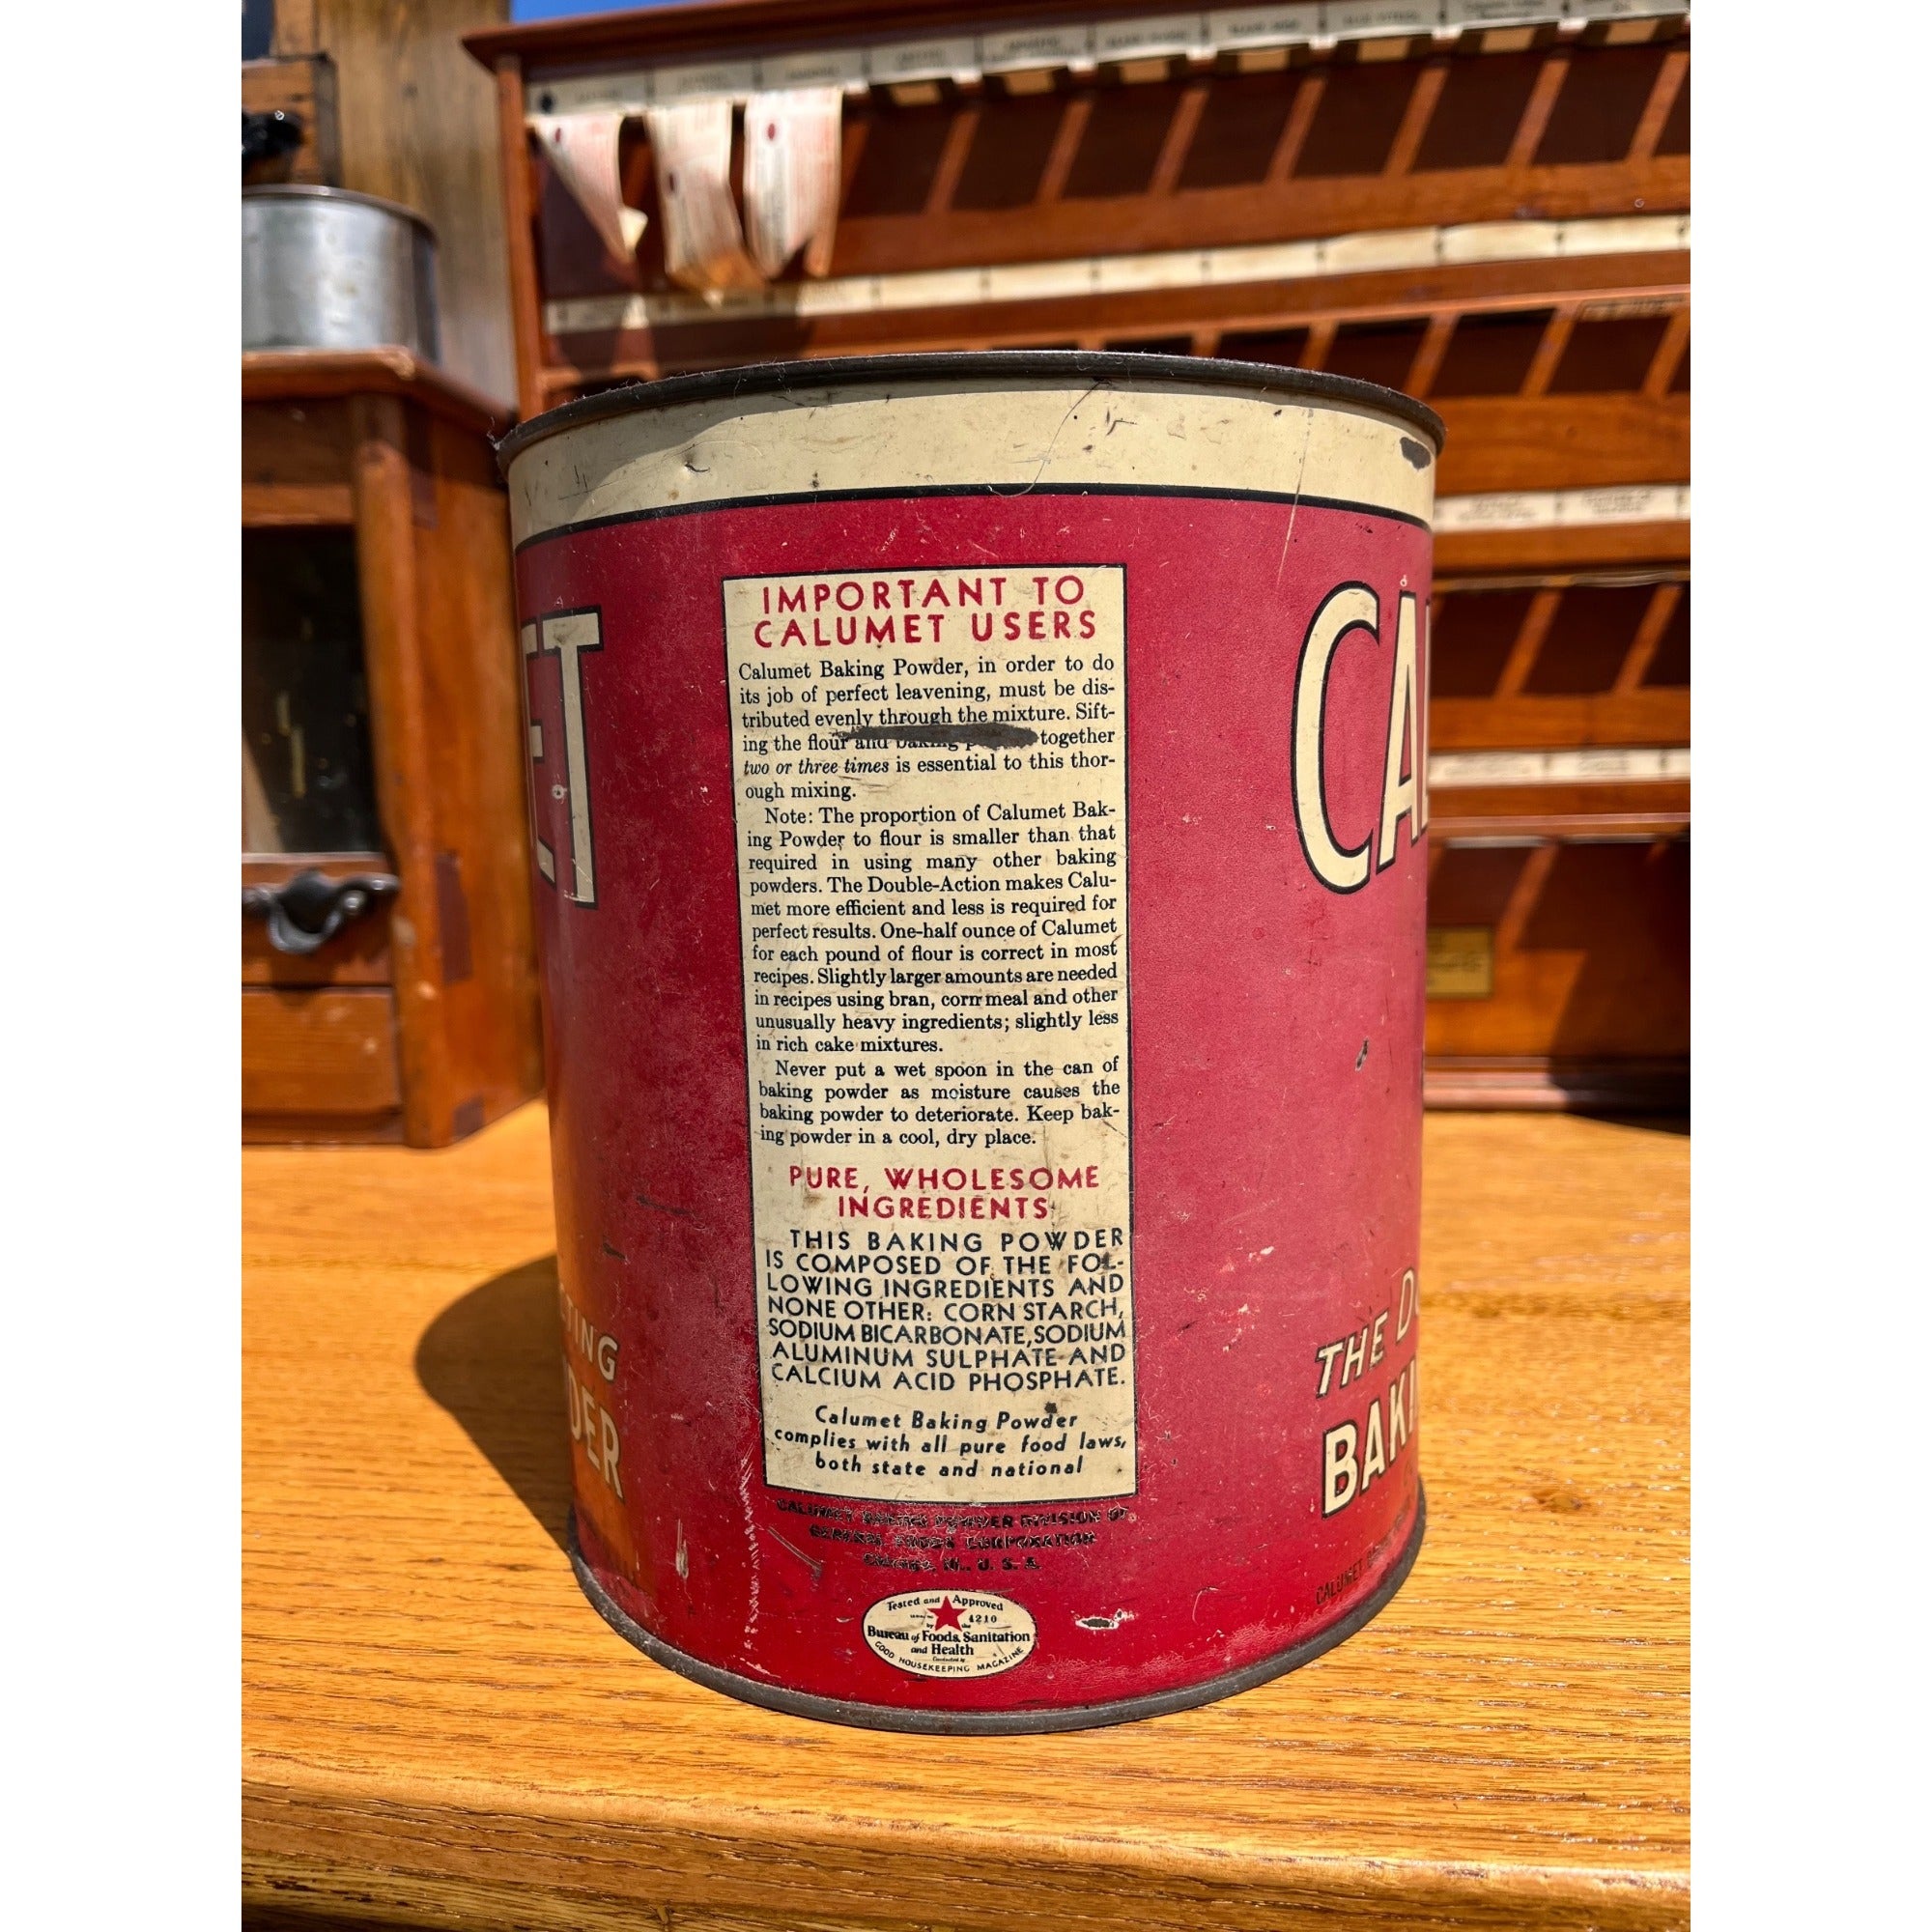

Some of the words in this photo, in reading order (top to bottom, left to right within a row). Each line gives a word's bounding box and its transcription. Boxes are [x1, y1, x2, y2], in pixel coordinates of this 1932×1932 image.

[763, 578, 1007, 614] IMPORTANT
[1033, 575, 1084, 606] TO
[754, 614, 945, 648] CALUMET
[972, 610, 1095, 641] USERS
[738, 662, 811, 680] Calumet
[819, 660, 885, 680] Baking
[893, 657, 969, 678] Powder,
[978, 657, 997, 673] in
[1006, 654, 1056, 673] order
[1065, 655, 1084, 671] to
[1093, 653, 1114, 670] do
[740, 687, 760, 704] its
[767, 686, 793, 707] job
[801, 685, 818, 702] of
[826, 684, 889, 706] perfect
[895, 683, 990, 702] leavening,
[999, 680, 1046, 697] must
[1054, 678, 1075, 696] be
[1082, 678, 1115, 696] dis-
[742, 711, 810, 728] tributed
[815, 712, 871, 727] evenly
[879, 707, 952, 725] through
[958, 707, 988, 724] the
[993, 706, 1070, 723] mixture.
[1076, 702, 1116, 720] Sift-
[745, 781, 785, 803] ough
[791, 785, 856, 802] mixing.
[764, 807, 812, 824] Note:
[818, 807, 854, 824] The
[860, 807, 956, 827] proportion
[962, 804, 980, 821] of
[987, 803, 1066, 821] Calumet
[1072, 800, 1116, 818] Bak-
[749, 853, 817, 874] required
[832, 855, 850, 869] in
[864, 858, 912, 873] using
[926, 855, 978, 872] many
[993, 850, 1041, 868] other
[1056, 848, 1117, 867] baking
[750, 876, 822, 896] powders.
[827, 876, 863, 894] The
[867, 875, 1001, 893] Double-Action
[1005, 873, 1064, 891] makes
[1067, 870, 1117, 889] Calu-
[753, 923, 809, 942] perfect
[812, 922, 876, 939] results.
[880, 922, 958, 939] One-half
[962, 925, 1015, 938] ounce
[1019, 920, 1037, 937] of
[1041, 918, 1118, 936] Calumet
[753, 967, 814, 988] recipes.
[817, 967, 887, 988] Slightly
[890, 967, 942, 988] larger
[945, 968, 1023, 984] amounts
[1026, 971, 1054, 982] are
[1057, 961, 1118, 981] needed
[755, 1013, 836, 1034] unusually
[842, 1013, 896, 1033] heavy
[902, 1012, 1009, 1033] ingredients;
[1015, 1010, 1083, 1032] slightly
[1089, 1009, 1119, 1026] less
[756, 1037, 771, 1050] in
[776, 1036, 809, 1052] rich
[815, 1036, 855, 1052] cake
[860, 1037, 943, 1053] mixtures.
[759, 1080, 813, 1103] baking
[824, 1083, 889, 1103] powder
[900, 1088, 920, 1099] as
[931, 1085, 1010, 1099] moisture
[1023, 1084, 1080, 1099] causes
[1093, 1079, 1121, 1096] the
[760, 1102, 813, 1125] baking
[820, 1105, 884, 1125] powder
[890, 1107, 908, 1122] to
[915, 1105, 1018, 1122] deteriorate.
[1026, 1104, 1074, 1124] Keep
[1080, 1101, 1120, 1120] bak-
[789, 1165, 870, 1193] PURE,
[884, 1165, 1099, 1191] WHOLESOME
[838, 1196, 1048, 1220] INGREDIENTS
[790, 1229, 850, 1250] THIS
[867, 1232, 981, 1253] BAKING
[1001, 1227, 1123, 1252] POWDER
[766, 1249, 783, 1269] IS
[796, 1253, 941, 1275] COMPOSED
[955, 1256, 991, 1276] OF
[1003, 1255, 1051, 1275] THE
[1066, 1252, 1123, 1274] FOL-
[767, 1272, 872, 1297] LOWING
[883, 1274, 1054, 1299] INGREDIENTS
[1067, 1273, 1123, 1296] AND
[768, 1295, 837, 1319] NONE
[844, 1300, 931, 1321] OTHER:
[944, 1302, 1015, 1322] CORN
[1023, 1296, 1123, 1321] STARCH,
[561, 1284, 620, 1383] TING
[768, 1318, 856, 1343] SODIUM
[1316, 1309, 1389, 1398] THE
[1396, 1266, 1420, 1345] D
[772, 1341, 914, 1367] ALUMINUM
[926, 1348, 1056, 1369] SULPHATE
[1068, 1343, 1125, 1366] AND
[772, 1363, 881, 1389] CALCIUM
[893, 1371, 955, 1391] ACID
[969, 1366, 1125, 1393] PHOSPHATE.
[565, 1360, 625, 1503] DER
[815, 1405, 901, 1428] Calumet
[912, 1410, 987, 1434] Baking
[996, 1407, 1077, 1430] Powder
[774, 1428, 856, 1449] complies
[867, 1433, 910, 1452] with
[921, 1435, 948, 1453] all
[959, 1442, 1006, 1457] pure
[1021, 1433, 1067, 1457] food
[1079, 1432, 1126, 1450] laws,
[1321, 1356, 1418, 1520] BAKI
[815, 1450, 861, 1472] both
[872, 1461, 925, 1476] state
[939, 1459, 979, 1477] and
[991, 1455, 1083, 1477] national
[1316, 1558, 1363, 1605] CALUMET
[887, 1598, 920, 1611] Tested
[924, 1596, 940, 1605] and
[952, 1595, 1004, 1611] Approved
[969, 1614, 998, 1623] 4210
[867, 1625, 909, 1641] Bureau
[911, 1633, 920, 1644] of
[963, 1632, 1031, 1642] Sanitation
[874, 1640, 895, 1659] GOOD
[898, 1658, 970, 1673] HOUSEKEEPING
[977, 1646, 1024, 1671] MAGAZINE
[931, 1643, 974, 1655] Health
